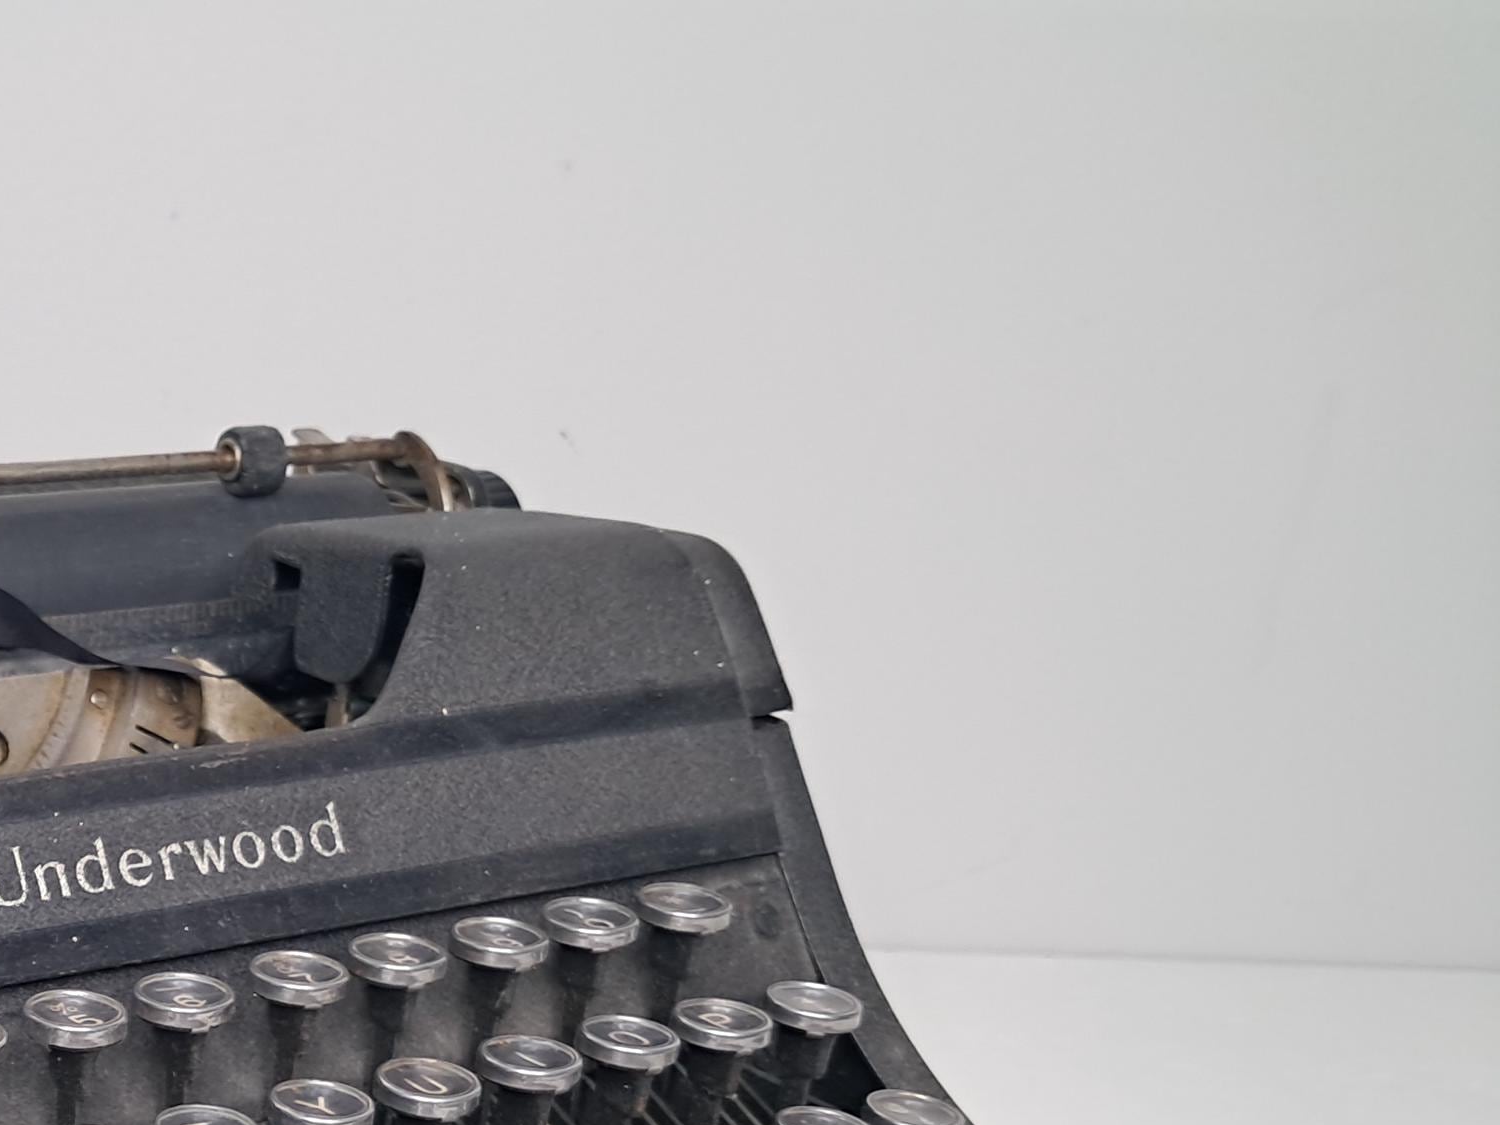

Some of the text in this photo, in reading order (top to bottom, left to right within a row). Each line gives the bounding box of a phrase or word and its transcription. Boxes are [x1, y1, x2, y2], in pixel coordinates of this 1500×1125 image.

[172, 993, 206, 1008] 6
[68, 1014, 103, 1027] 5
[697, 1012, 732, 1028] P
[609, 1029, 650, 1046] O
[402, 1075, 449, 1095] U
[295, 1096, 336, 1116] Y
